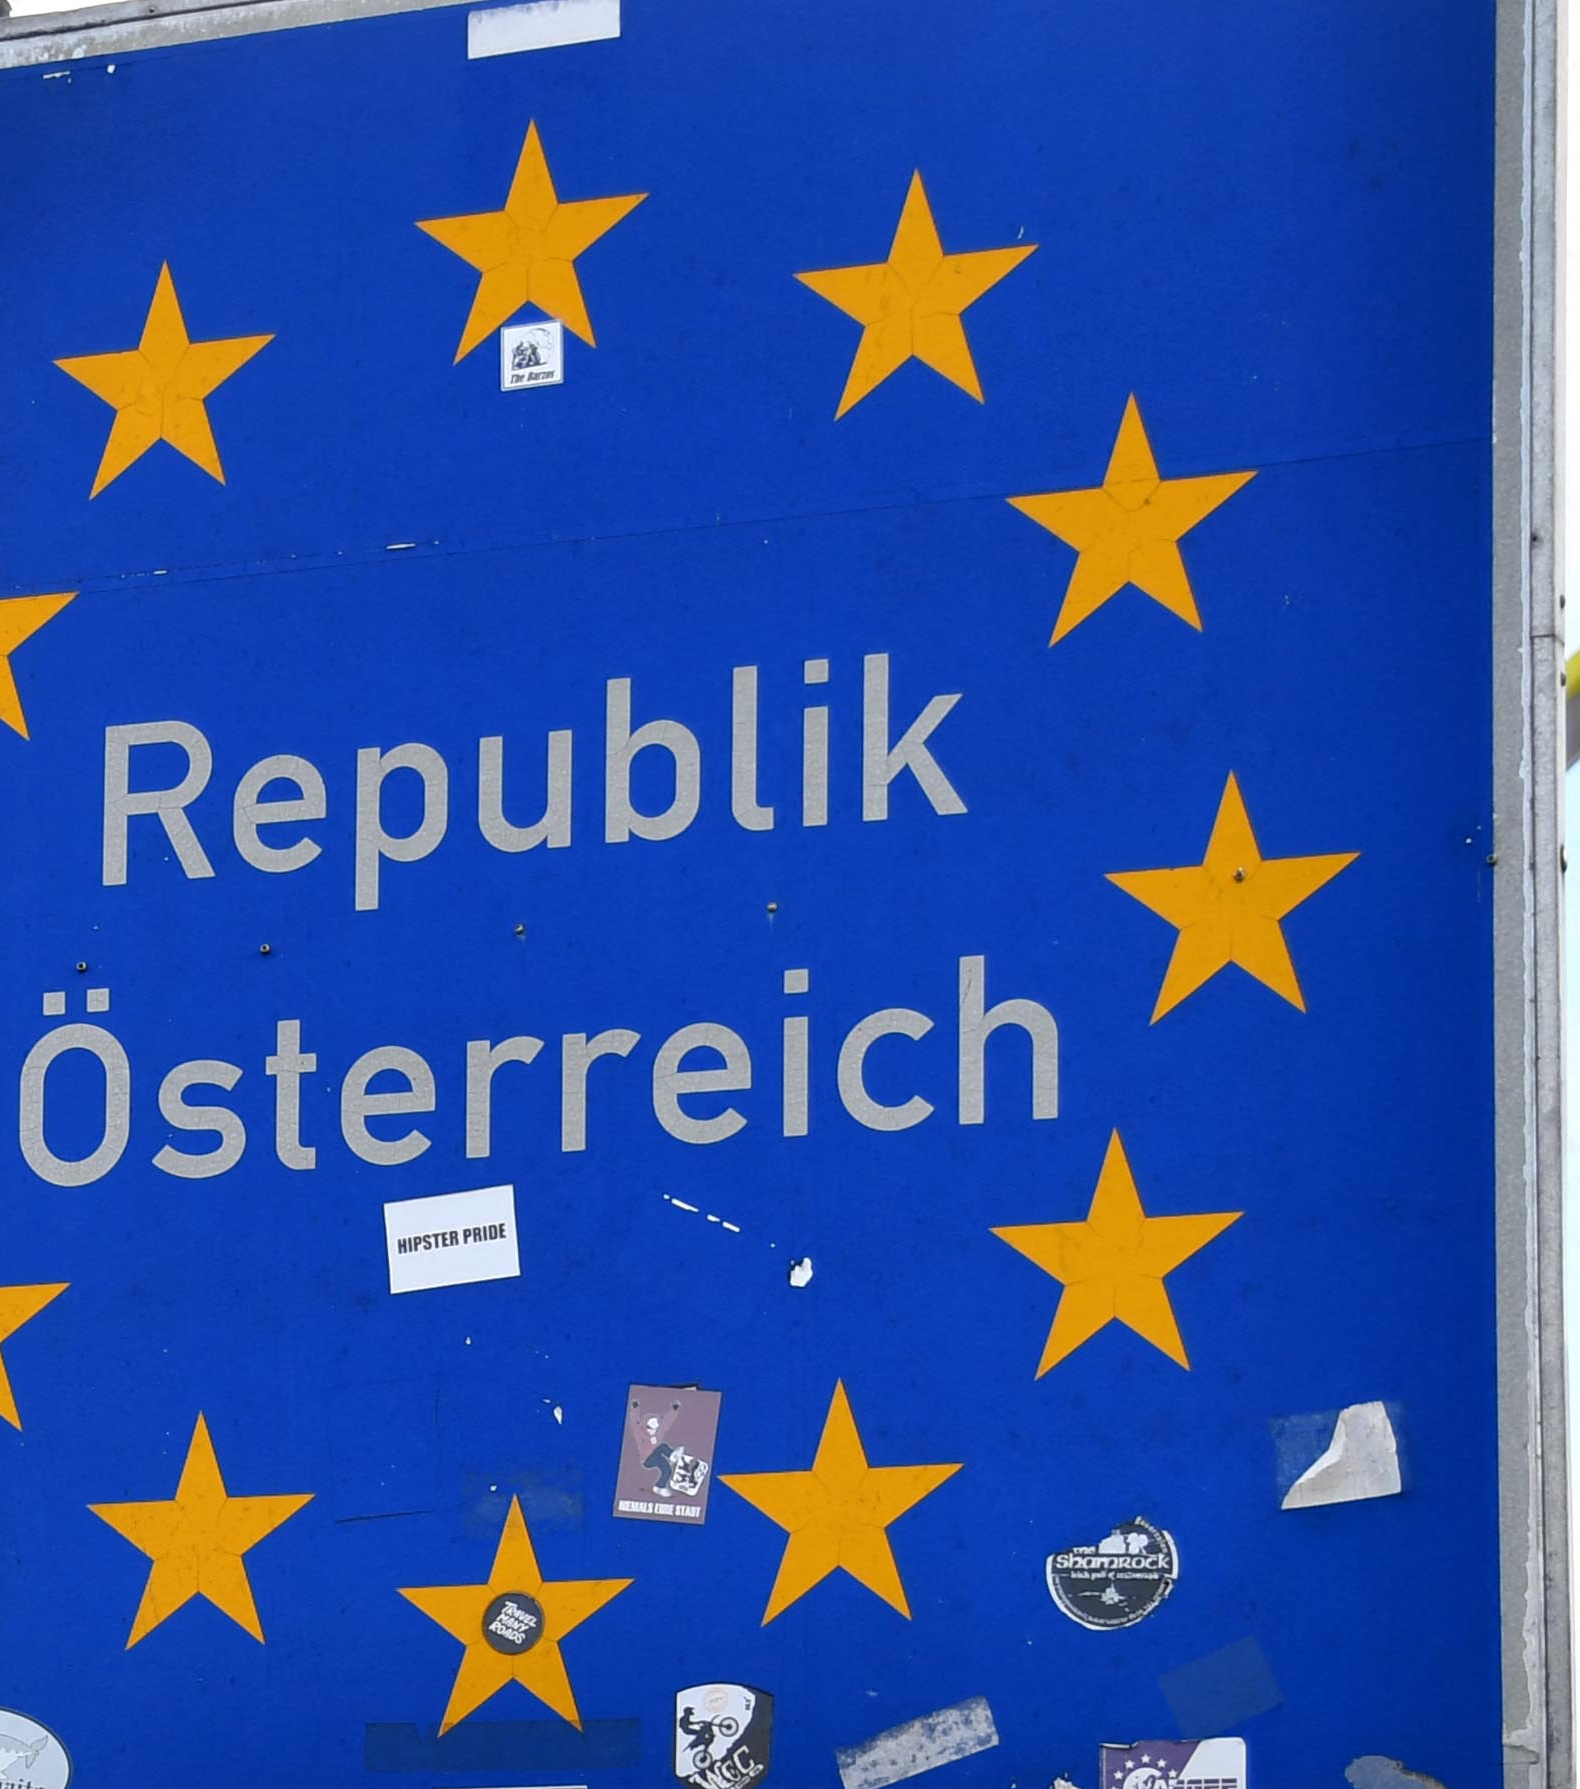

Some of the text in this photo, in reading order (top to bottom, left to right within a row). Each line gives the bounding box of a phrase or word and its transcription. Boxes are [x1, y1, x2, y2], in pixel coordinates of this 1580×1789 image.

[102, 653, 969, 911] Republik
[19, 955, 1060, 1188] Österreich
[397, 1223, 507, 1255] HIPSTER PRIDE
[675, 1504, 702, 1518] STADT
[488, 1600, 538, 1645] TRAVEL MANY ROADS
